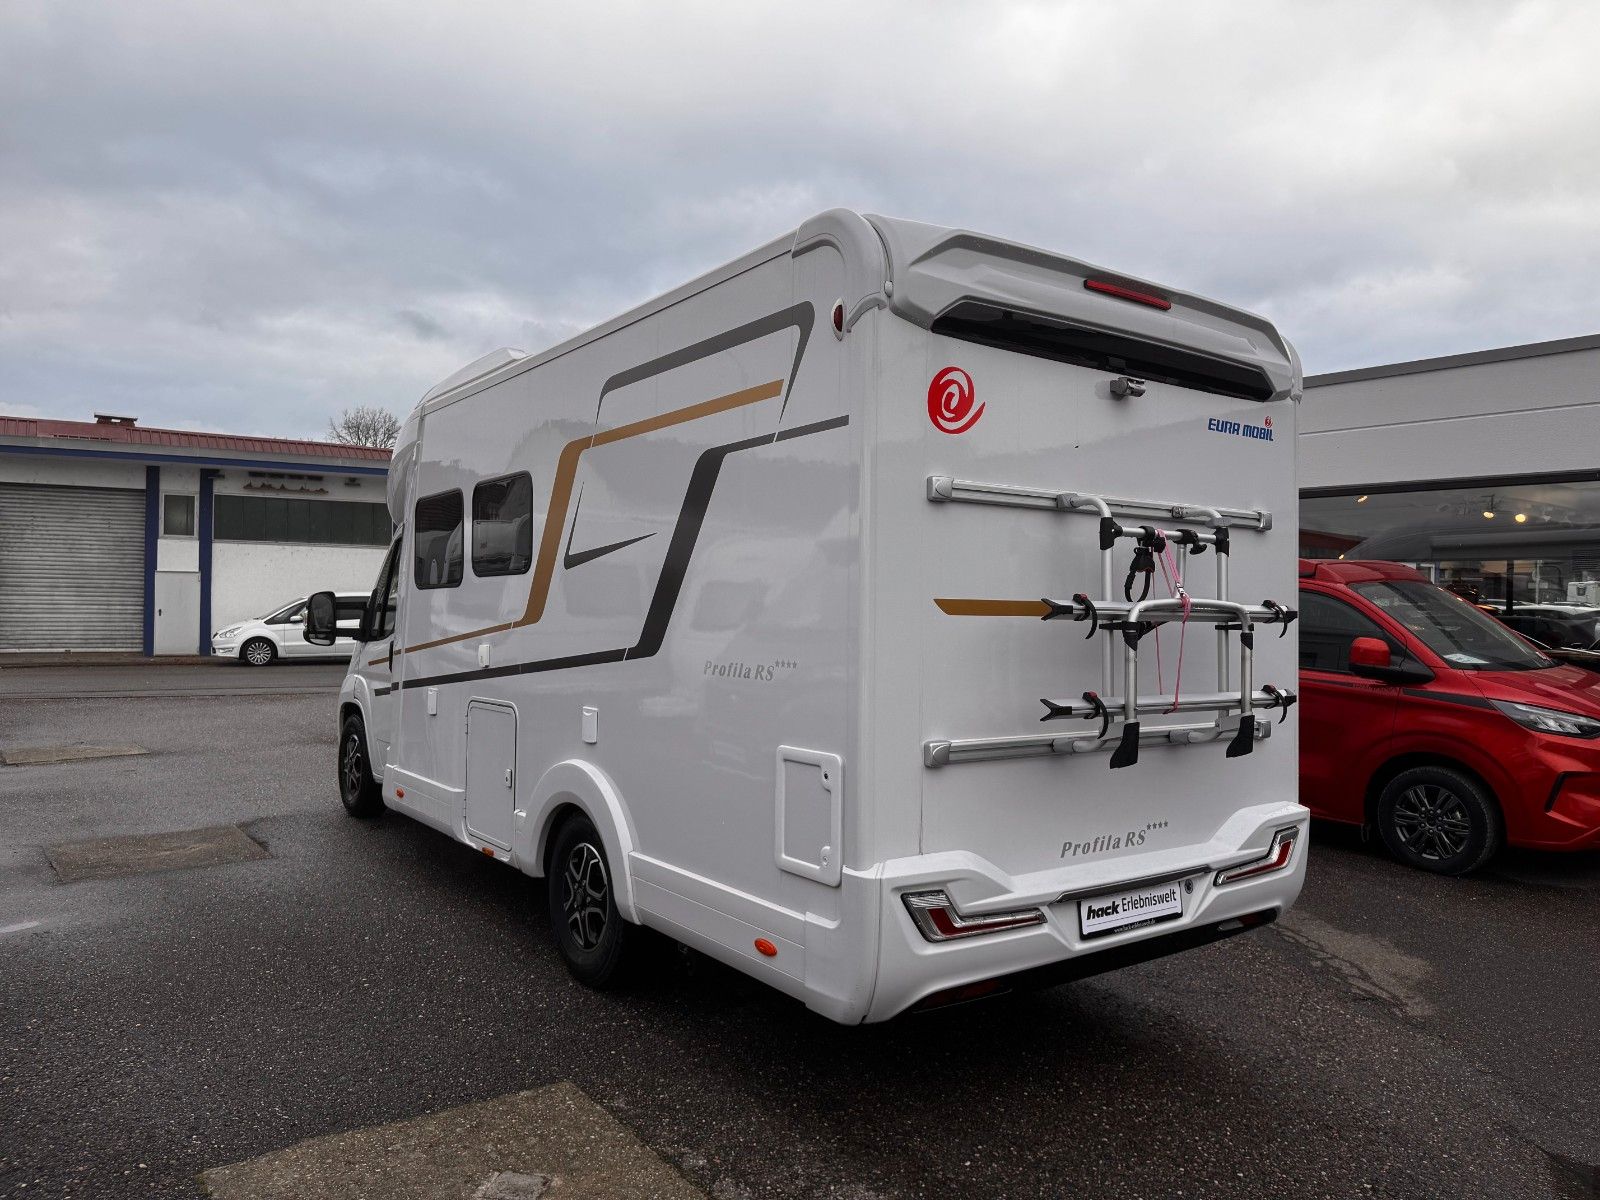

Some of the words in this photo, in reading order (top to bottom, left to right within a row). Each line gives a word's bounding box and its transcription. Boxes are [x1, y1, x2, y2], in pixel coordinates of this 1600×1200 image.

[1208, 418, 1240, 435] EURA
[1242, 424, 1274, 441] MOBIL
[703, 660, 752, 679] Profila
[755, 664, 775, 681] RS
[1060, 834, 1121, 858] Profila
[1125, 829, 1146, 847] RS
[1086, 901, 1120, 920] hack
[1121, 888, 1177, 912] Erlebniswelt
